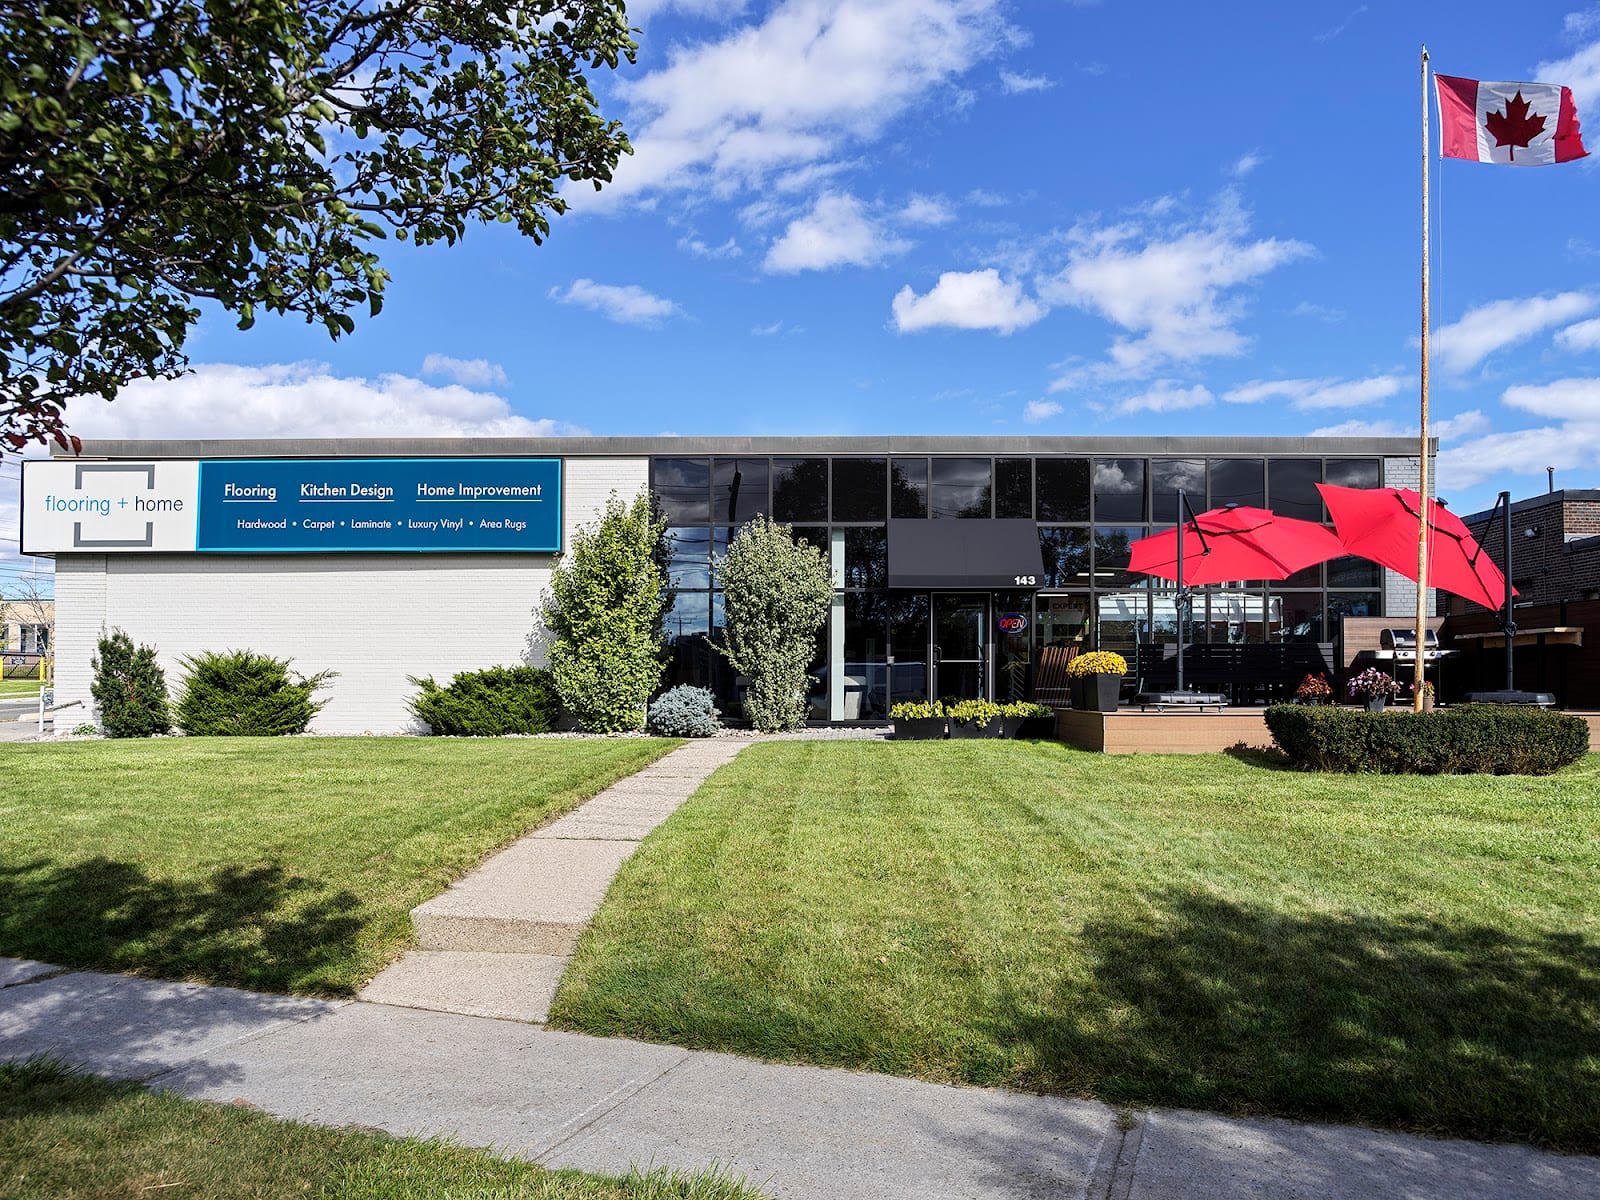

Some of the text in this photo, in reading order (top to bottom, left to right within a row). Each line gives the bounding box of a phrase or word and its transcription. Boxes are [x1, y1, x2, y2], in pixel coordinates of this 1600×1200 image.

[224, 483, 277, 499] Flooring
[300, 483, 394, 499] Kitchen Design
[417, 483, 542, 499] Home Improvement
[45, 495, 111, 516] flooring
[135, 496, 184, 512] home
[237, 518, 527, 531] Hardwood Carpet Laminate Luxury Vinyl Area Rugs
[1014, 575, 1036, 586] 143
[1000, 618, 1025, 629] OPEN
